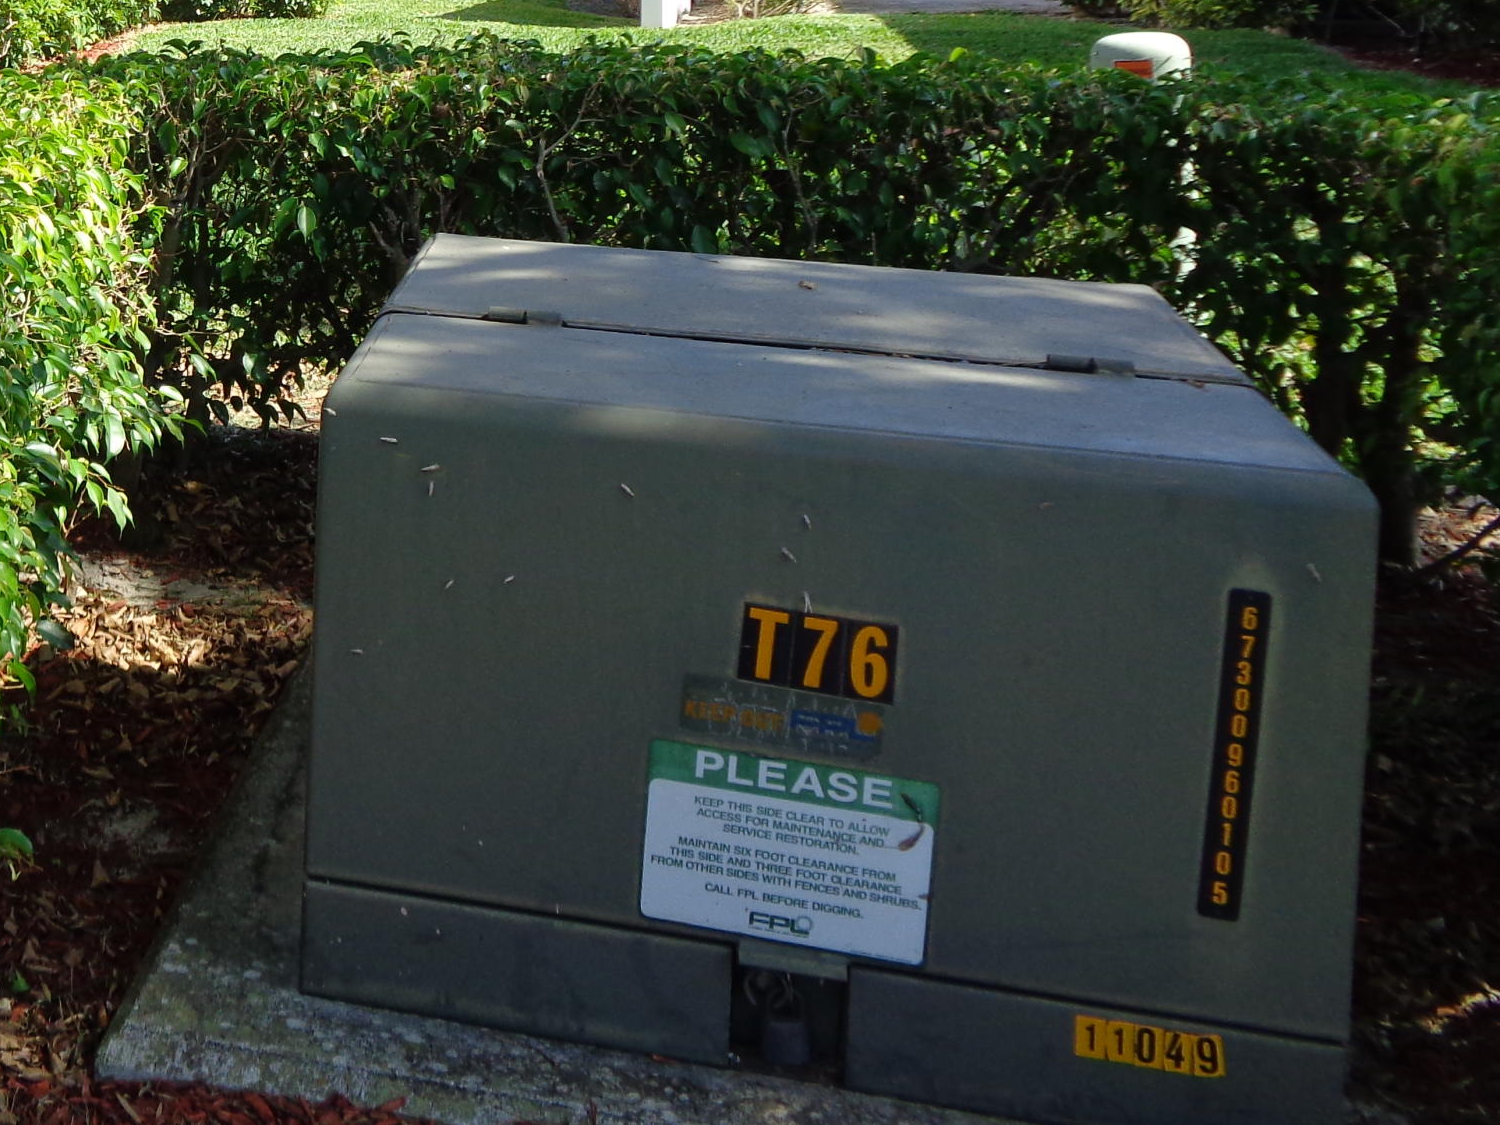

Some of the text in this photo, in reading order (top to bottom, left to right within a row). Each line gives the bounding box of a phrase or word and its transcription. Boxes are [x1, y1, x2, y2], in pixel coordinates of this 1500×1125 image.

[748, 606, 889, 699] T76
[694, 749, 893, 810] PLEASE
[694, 796, 890, 837] KEEP THIS SIDE CLEAR TO ALLOW
[697, 808, 884, 848] ACCESS FOR MAINTENANCE AND
[723, 824, 859, 855] SERVICE RESTORATION.
[651, 854, 922, 910] FROM OTHER SIDES WITH FENCES AND SHRUBS.
[670, 846, 902, 894] THIS SIDE AND THREE FOOT CLEARANCE
[678, 836, 896, 882] MAINTAIN SIX FOOT CLEARANCE FROM
[705, 882, 863, 919] CALL FPL BEFORE DIGGING.
[749, 911, 810, 935] FPL
[1086, 1024, 1219, 1075] 11049
